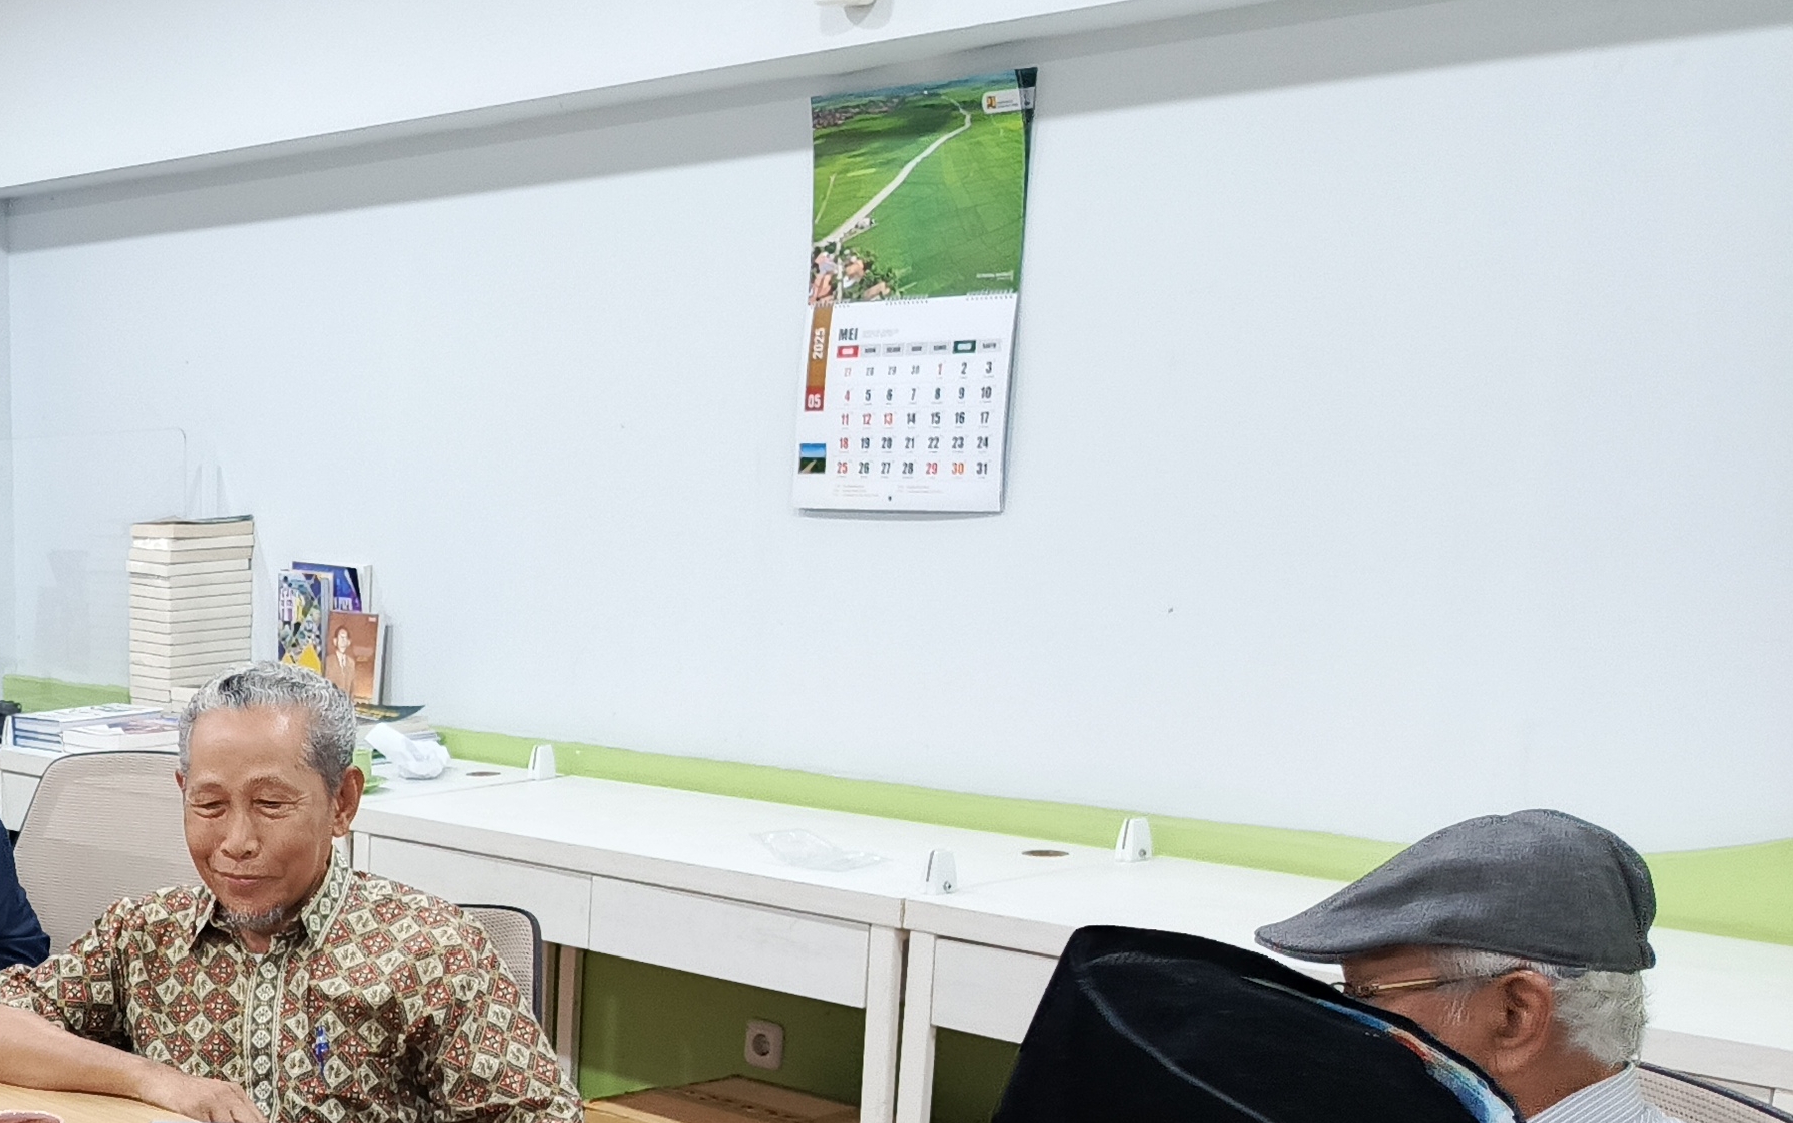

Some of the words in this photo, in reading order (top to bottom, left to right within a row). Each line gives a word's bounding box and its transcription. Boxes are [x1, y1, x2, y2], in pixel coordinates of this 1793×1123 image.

[838, 328, 859, 341] MEI
[813, 327, 826, 360] 2025
[938, 363, 943, 376] 1
[961, 361, 968, 375] 2
[985, 361, 993, 374] 3
[807, 394, 821, 408] 05
[844, 390, 850, 402] 4
[865, 389, 872, 402] 5
[886, 388, 893, 401] 6
[911, 388, 917, 401] 7
[935, 387, 941, 400] 8
[958, 387, 965, 399] 9
[981, 386, 992, 399] 10
[841, 413, 849, 426] 11
[862, 413, 872, 425] 12
[883, 412, 893, 425] 13
[907, 413, 916, 425] 14
[931, 411, 941, 425] 15
[955, 411, 965, 424] 16
[980, 411, 990, 424] 17
[839, 437, 849, 449] 18
[861, 437, 870, 449] 19
[881, 436, 893, 449] 20
[905, 436, 915, 449] 21
[927, 436, 940, 449] 22
[952, 436, 964, 449] 23
[977, 436, 989, 449] 24
[837, 461, 848, 474] 25
[858, 462, 870, 474] 26
[881, 462, 891, 475] 27
[902, 462, 914, 475] 28
[925, 462, 938, 475] 29
[951, 462, 965, 475] 30
[976, 462, 988, 475] 31
